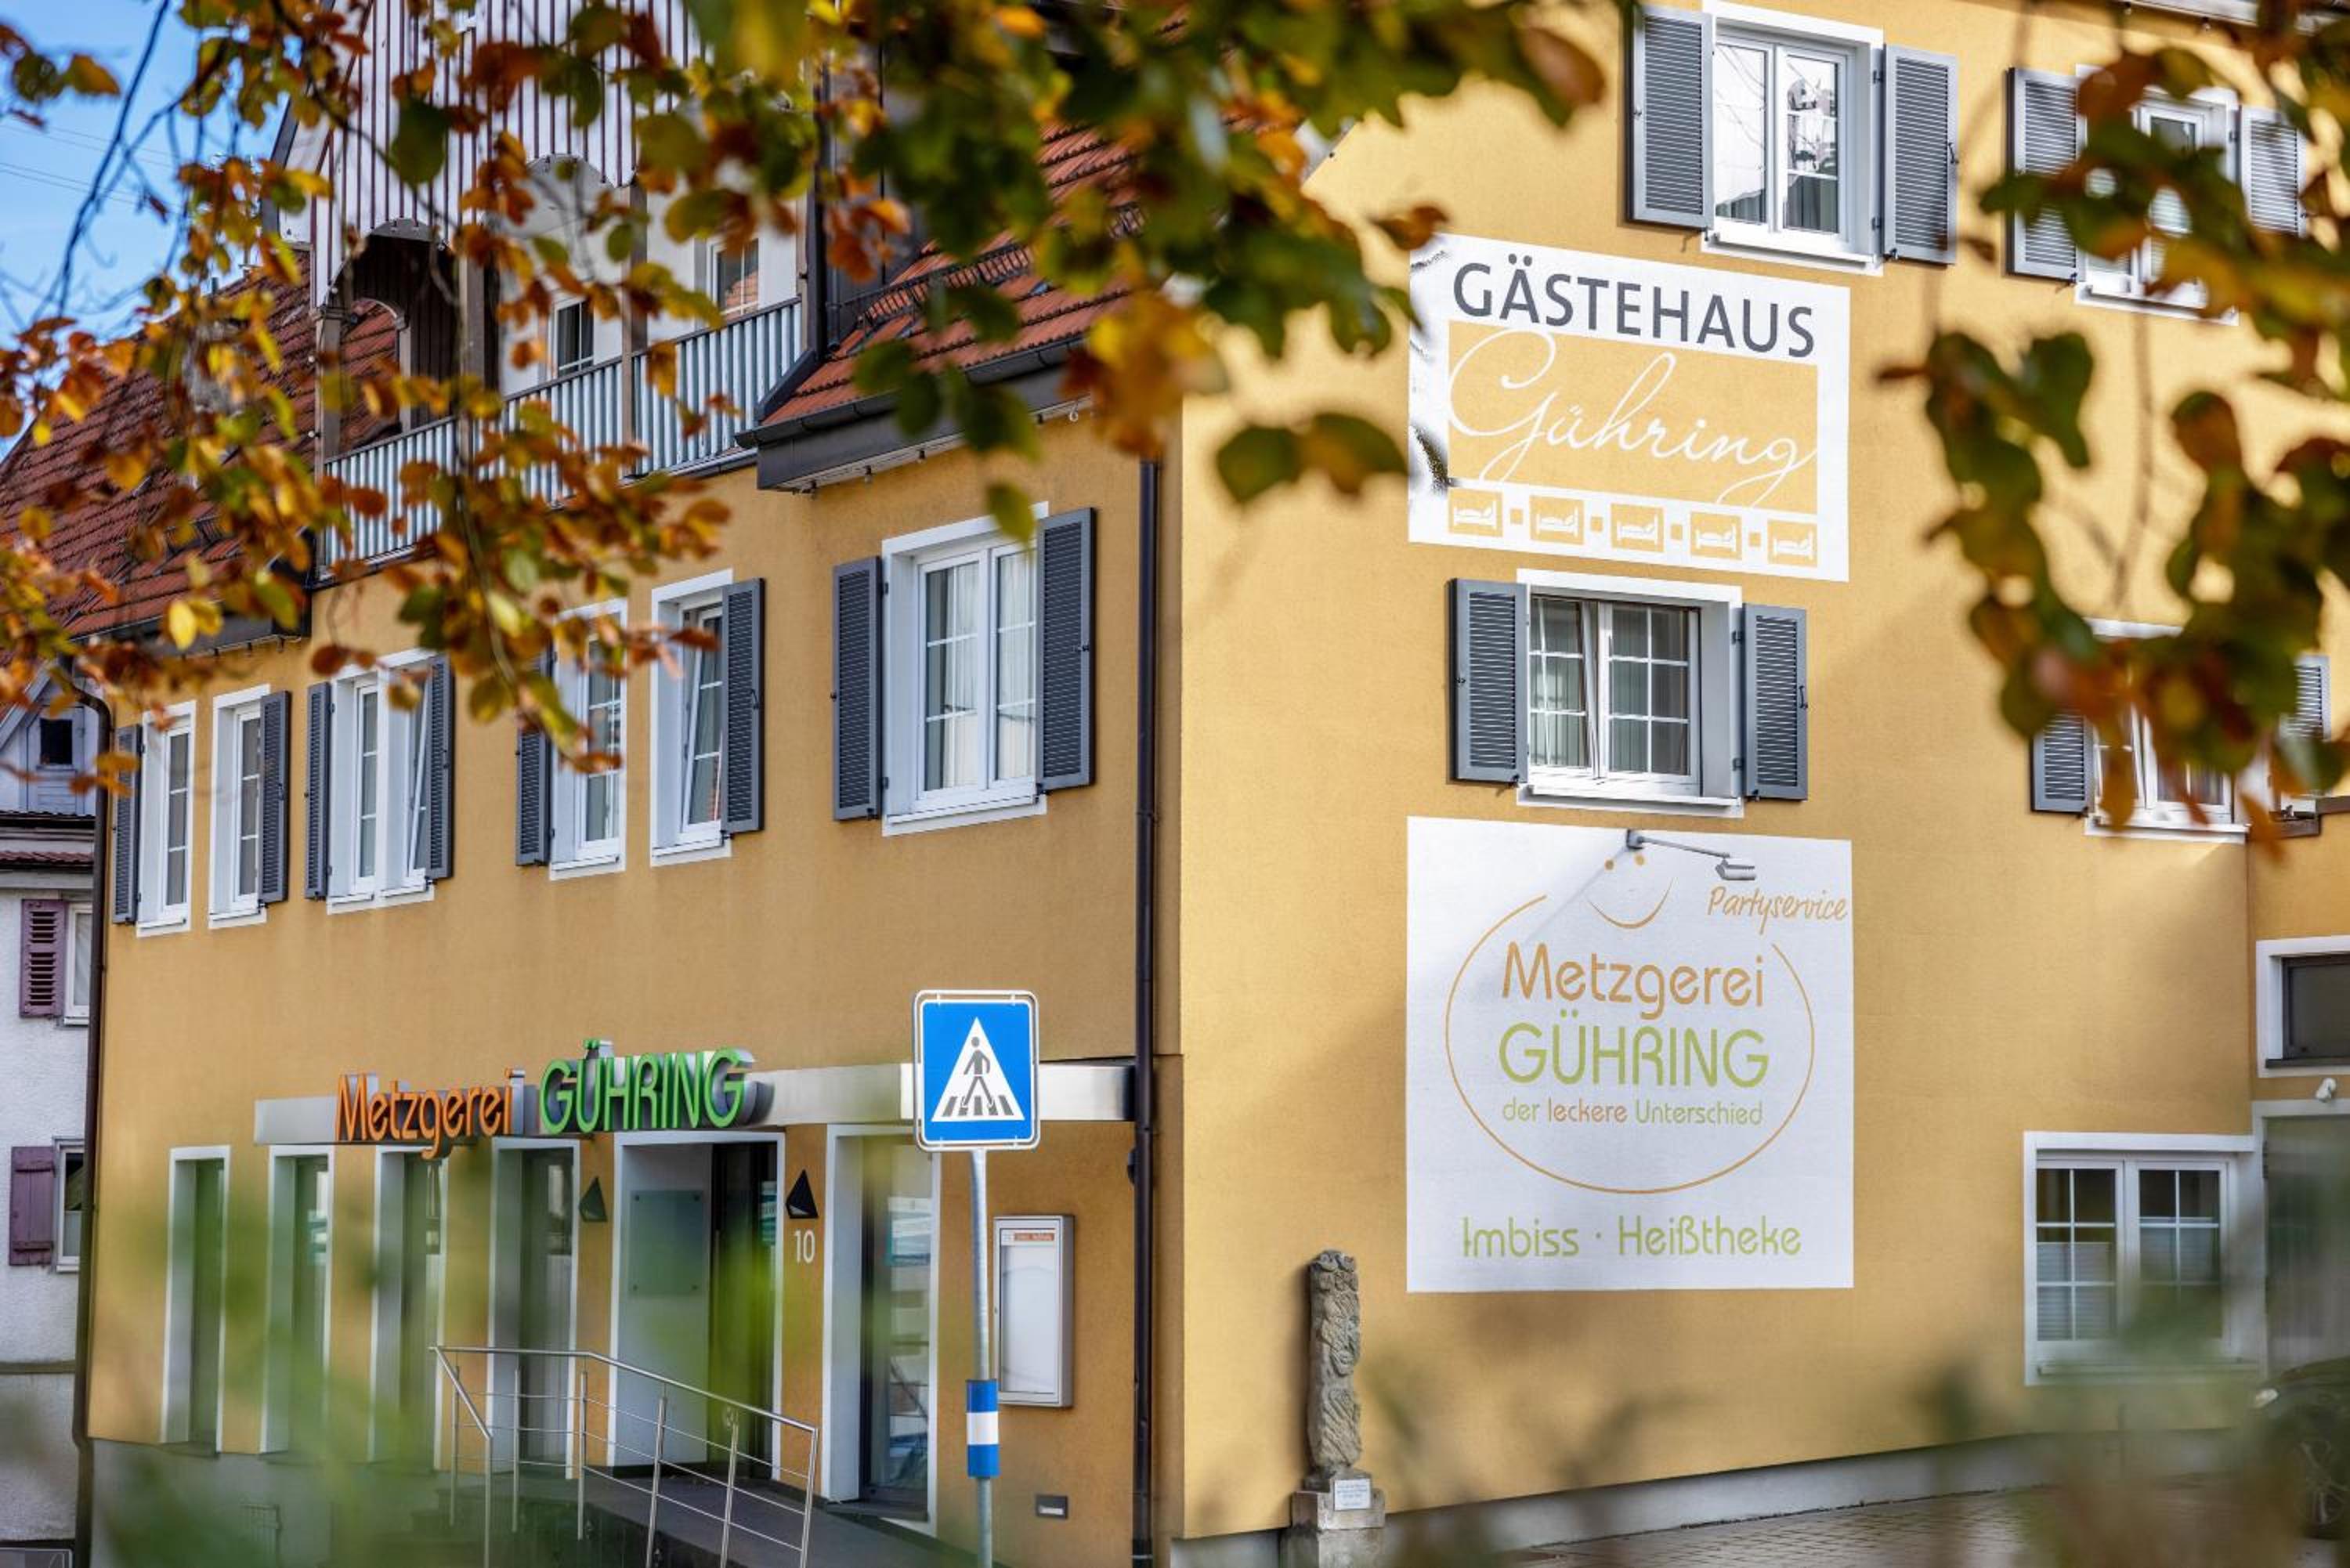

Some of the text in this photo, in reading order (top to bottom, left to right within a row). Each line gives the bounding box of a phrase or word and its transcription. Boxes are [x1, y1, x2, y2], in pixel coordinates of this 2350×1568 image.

[1452, 252, 1816, 358] GÄSTEHAUS
[1448, 327, 1818, 508] Gühring
[1707, 886, 1848, 935] Partyservice
[1502, 941, 1764, 1021] Metzgerei
[540, 1038, 750, 1136] GÜHRING
[1499, 1008, 1770, 1089] GÜHRING
[334, 1070, 519, 1158] Metzgerei
[1502, 1097, 1762, 1126] der leckere Unterschied
[794, 1228, 815, 1264] 10
[1462, 1215, 1802, 1258] Imbiss Heißtheke
